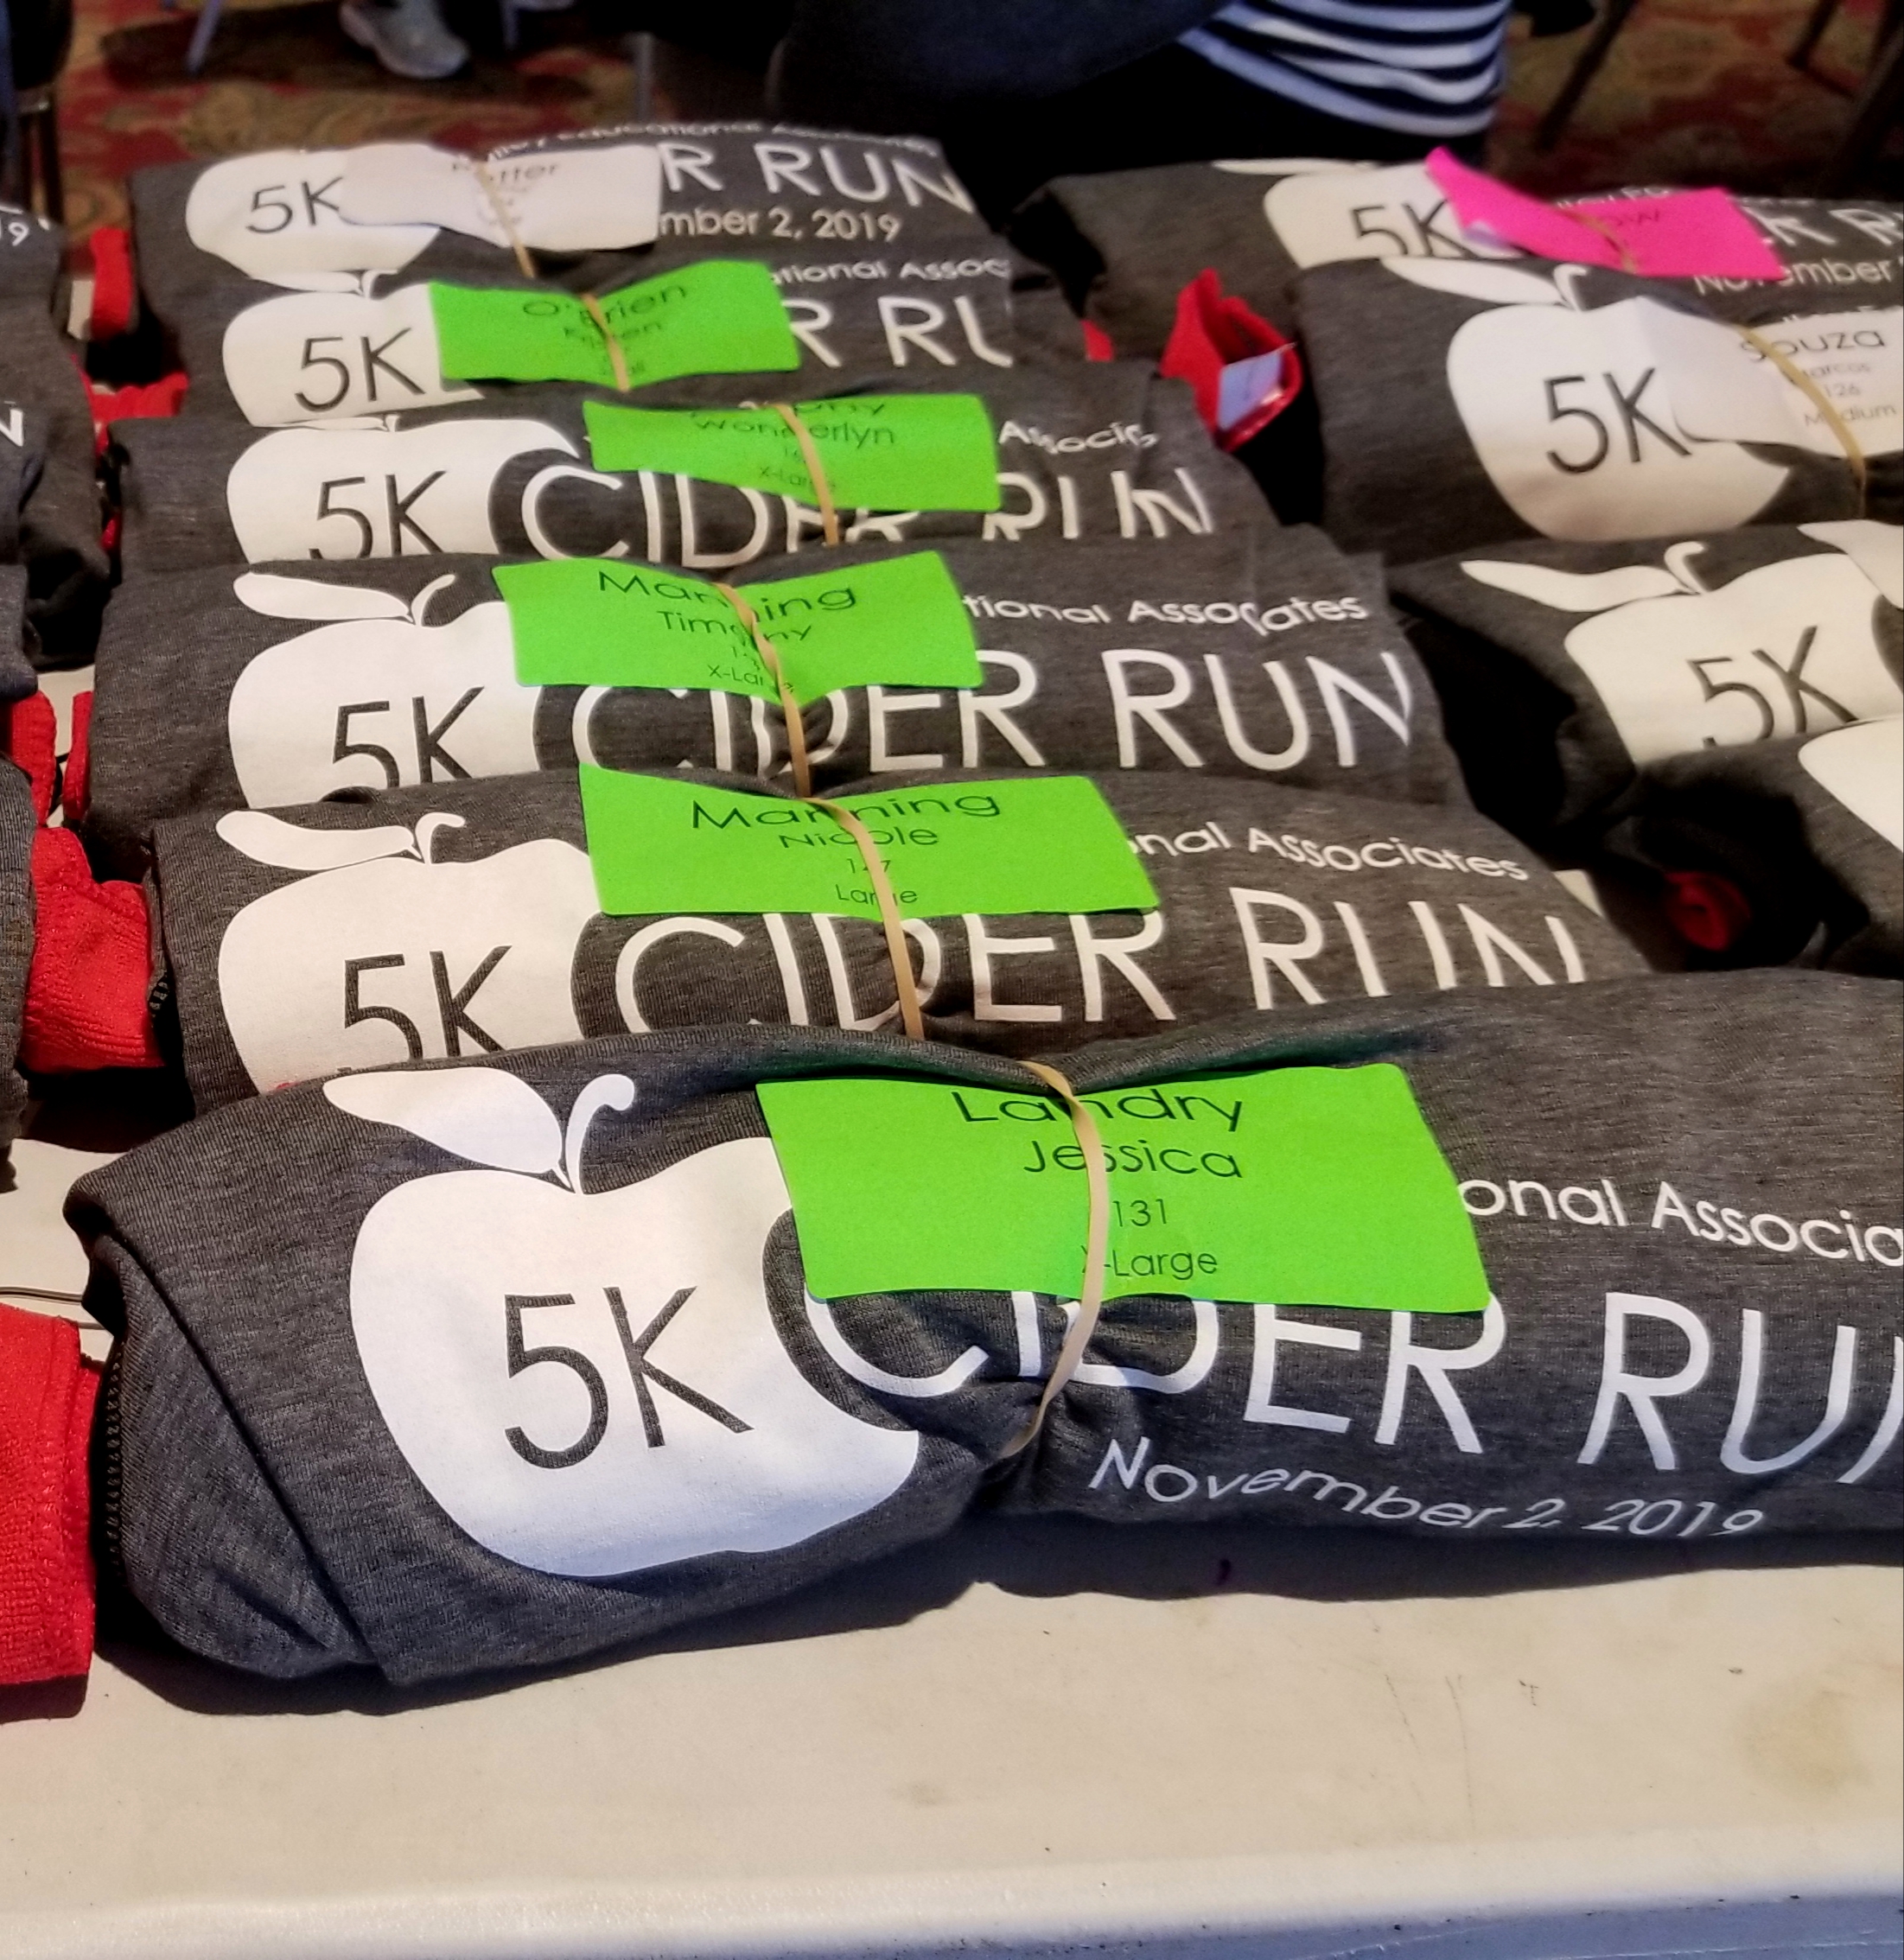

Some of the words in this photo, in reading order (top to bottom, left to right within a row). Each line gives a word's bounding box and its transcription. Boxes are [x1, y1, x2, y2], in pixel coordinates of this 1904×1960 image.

[246, 175, 343, 234] 5K
[754, 143, 974, 214] RUN
[768, 207, 802, 240] 2,
[812, 208, 902, 244] 2019
[295, 327, 426, 413] 5K
[1543, 366, 1693, 474] 5K
[1805, 404, 1898, 428] Mdium
[309, 469, 445, 561] 5K
[1102, 648, 1411, 772] RUN
[1684, 625, 1860, 748] 5K
[330, 686, 486, 790] 5K
[692, 793, 1002, 830] Manning
[778, 825, 939, 849] Nicole
[845, 856, 892, 875] 17
[1248, 827, 1528, 881] Associates
[343, 945, 513, 1061] 5K
[615, 913, 1177, 1034] CIDER
[952, 1087, 1243, 1132] Landry
[1023, 1139, 1243, 1179] Jessica
[1111, 1198, 1169, 1227] 131
[504, 1286, 755, 1469] 5K
[804, 1282, 1507, 1454] CIDER
[1088, 1435, 1507, 1530] November
[1581, 1499, 1764, 1537] 2019
